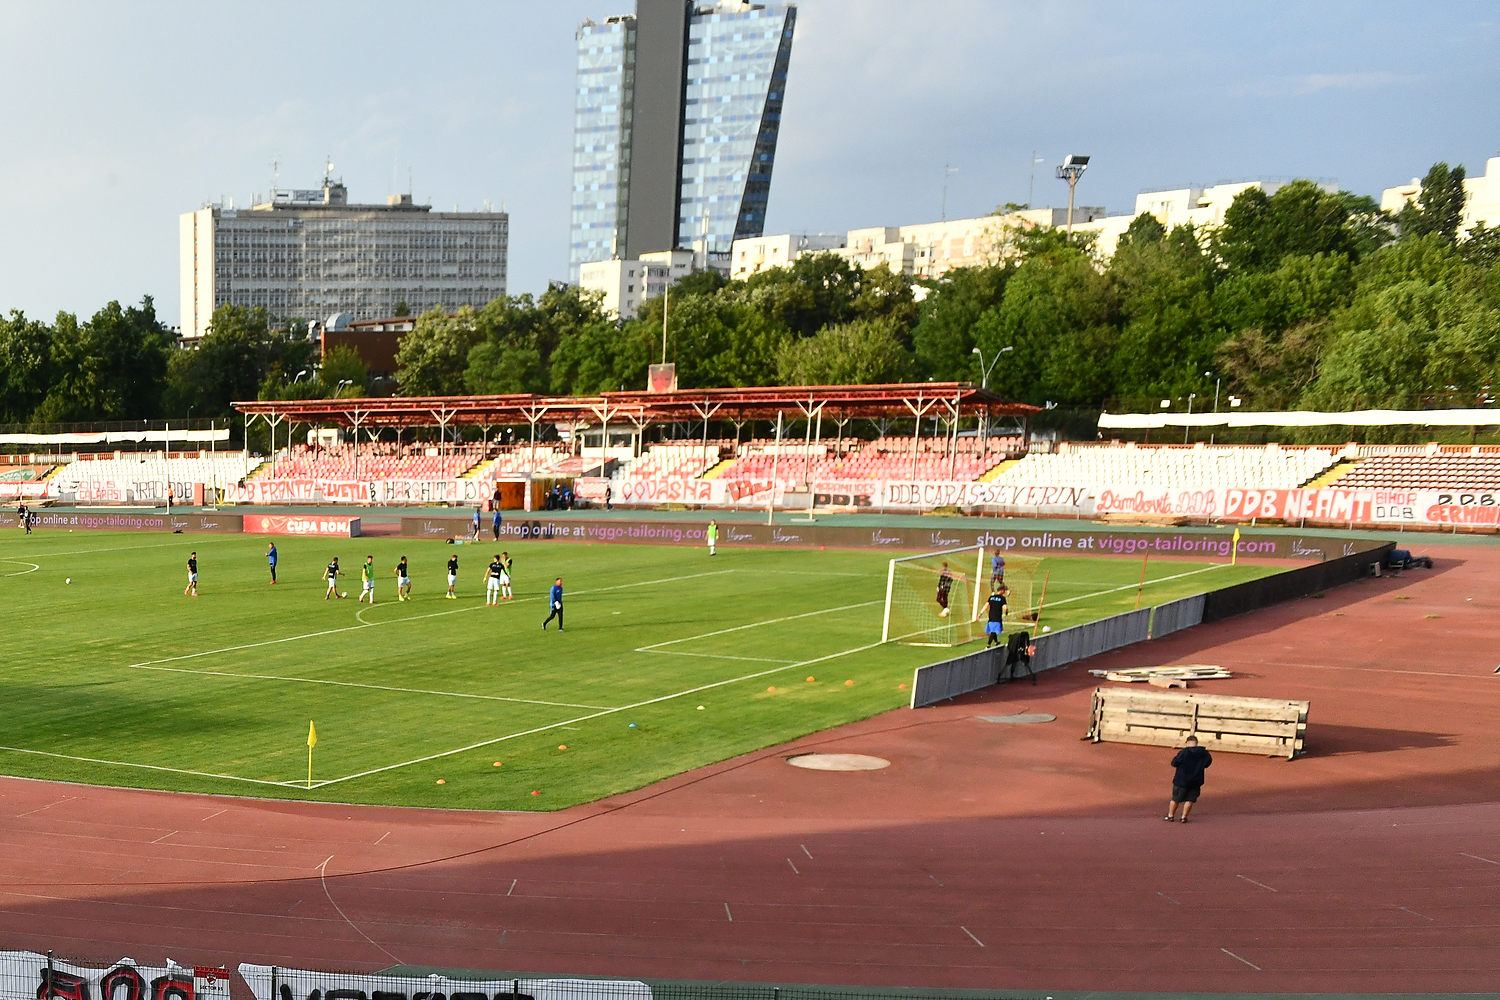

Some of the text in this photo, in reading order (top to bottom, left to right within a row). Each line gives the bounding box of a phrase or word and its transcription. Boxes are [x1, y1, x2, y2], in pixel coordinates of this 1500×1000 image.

[227, 481, 256, 500] DDB
[386, 481, 458, 501] HARGHITA
[622, 481, 712, 501] COVASNA
[1375, 491, 1417, 506] BIHOR
[813, 493, 874, 506] DDB
[1226, 490, 1278, 518] DDB
[45, 514, 69, 525] online
[69, 516, 79, 525] at
[80, 516, 164, 529] viggo-tailoring.com
[287, 519, 318, 532] CUPA
[500, 522, 529, 538] shop
[532, 523, 570, 536] online
[573, 525, 585, 536] at
[976, 531, 1017, 554] shop
[1020, 532, 1073, 549] online
[1077, 534, 1094, 549] at
